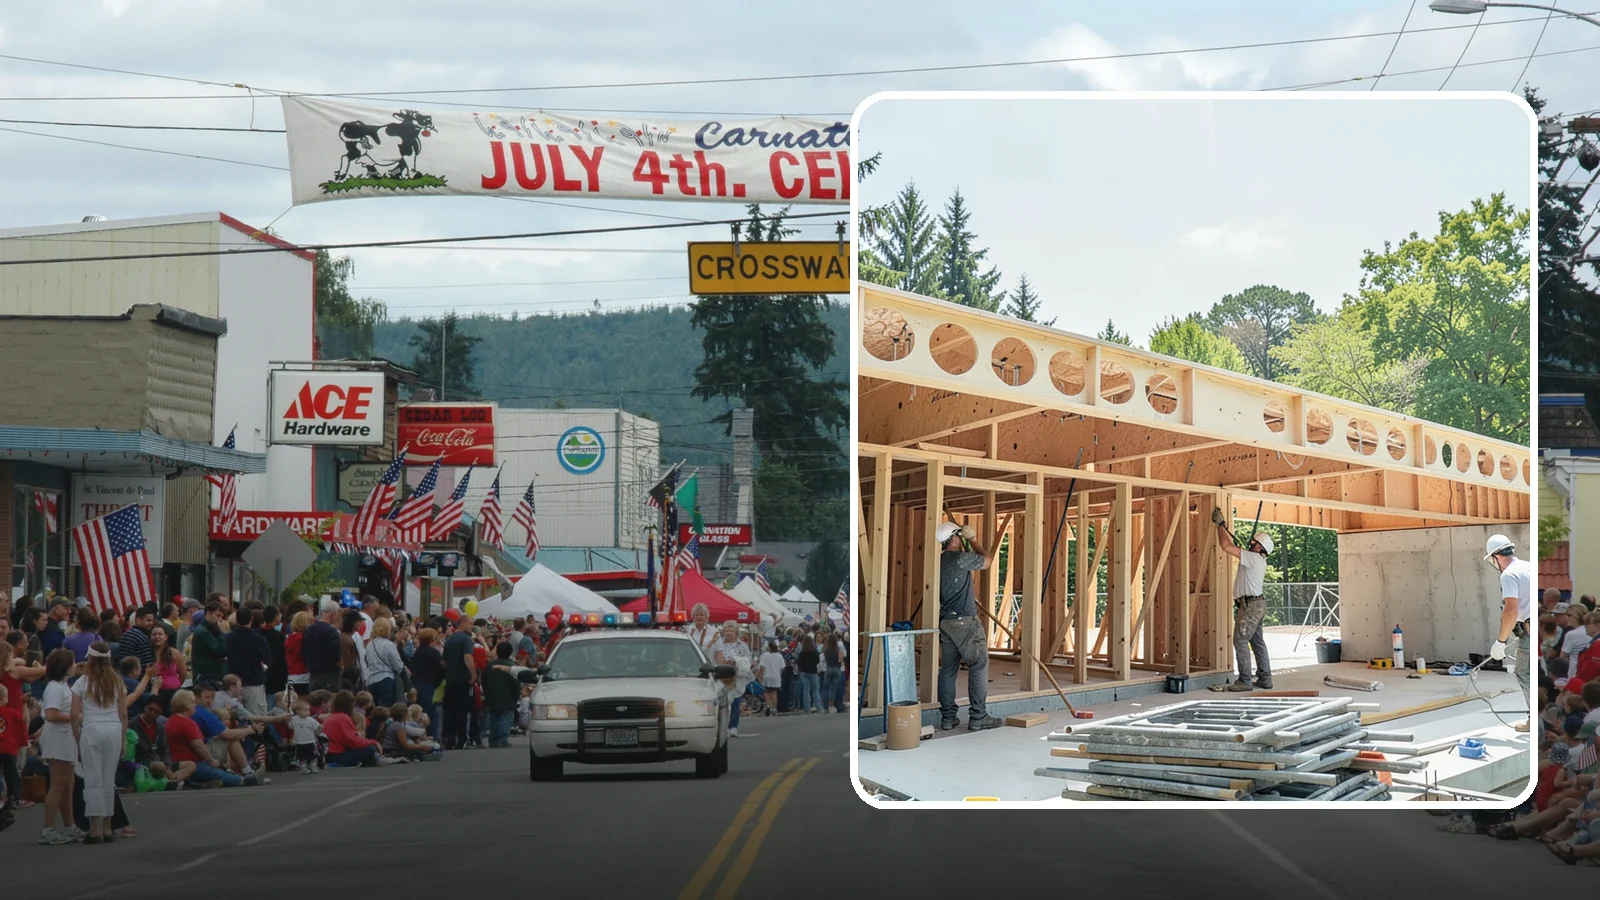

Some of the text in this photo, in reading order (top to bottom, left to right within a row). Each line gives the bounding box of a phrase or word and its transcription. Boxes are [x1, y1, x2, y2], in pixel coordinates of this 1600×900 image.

[481, 141, 605, 192] JULY
[632, 150, 746, 197] 4th.
[697, 254, 850, 280] CROSSWA
[283, 380, 373, 420] ACE
[405, 409, 452, 422] CEDAR
[283, 421, 371, 436] Hardware
[416, 428, 477, 447] Coca-Cola
[353, 467, 386, 480] Simpl
[95, 485, 124, 494] Vincent
[126, 485, 136, 495] de
[137, 486, 155, 495] Paul
[81, 503, 154, 522] THT
[688, 526, 741, 535] CRNATION
[699, 535, 730, 543] GLASS
